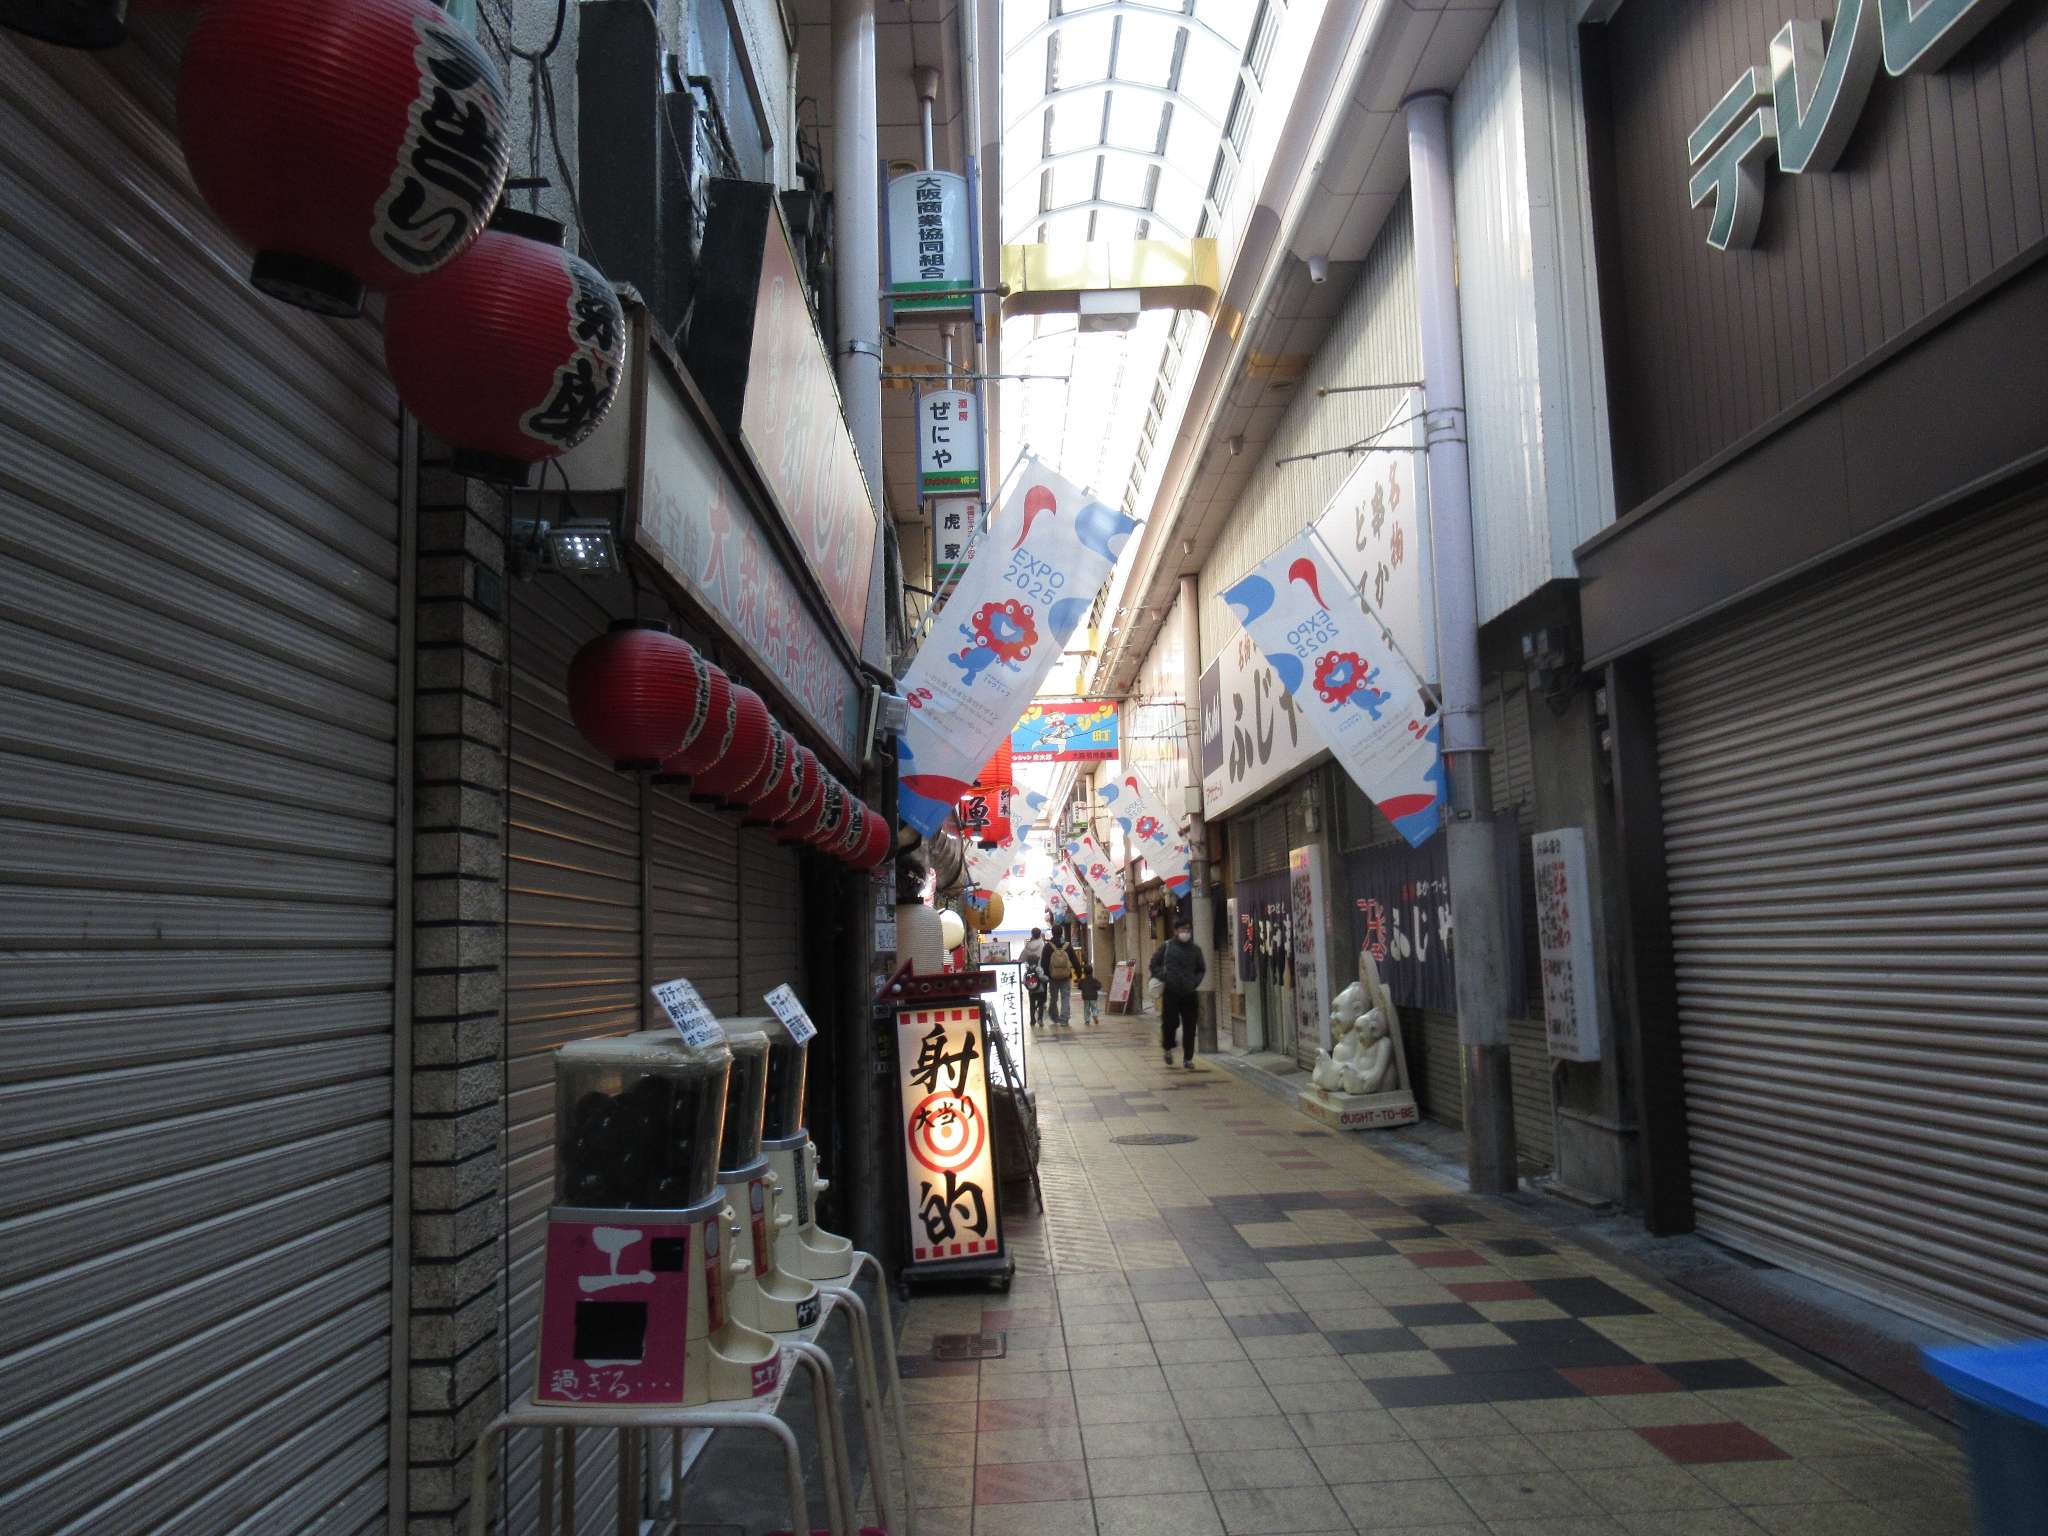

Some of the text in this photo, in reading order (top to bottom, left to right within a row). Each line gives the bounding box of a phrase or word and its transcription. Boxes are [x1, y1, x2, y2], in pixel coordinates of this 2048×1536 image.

[916, 177, 945, 279] 大阪商業協同組合
[930, 401, 952, 469] ぜにや
[944, 513, 961, 560] 虎家
[1002, 565, 1056, 607] 2025
[1012, 547, 1066, 590] EXPO
[909, 1023, 989, 1246] 射的
[915, 1096, 975, 1132] 大当り
